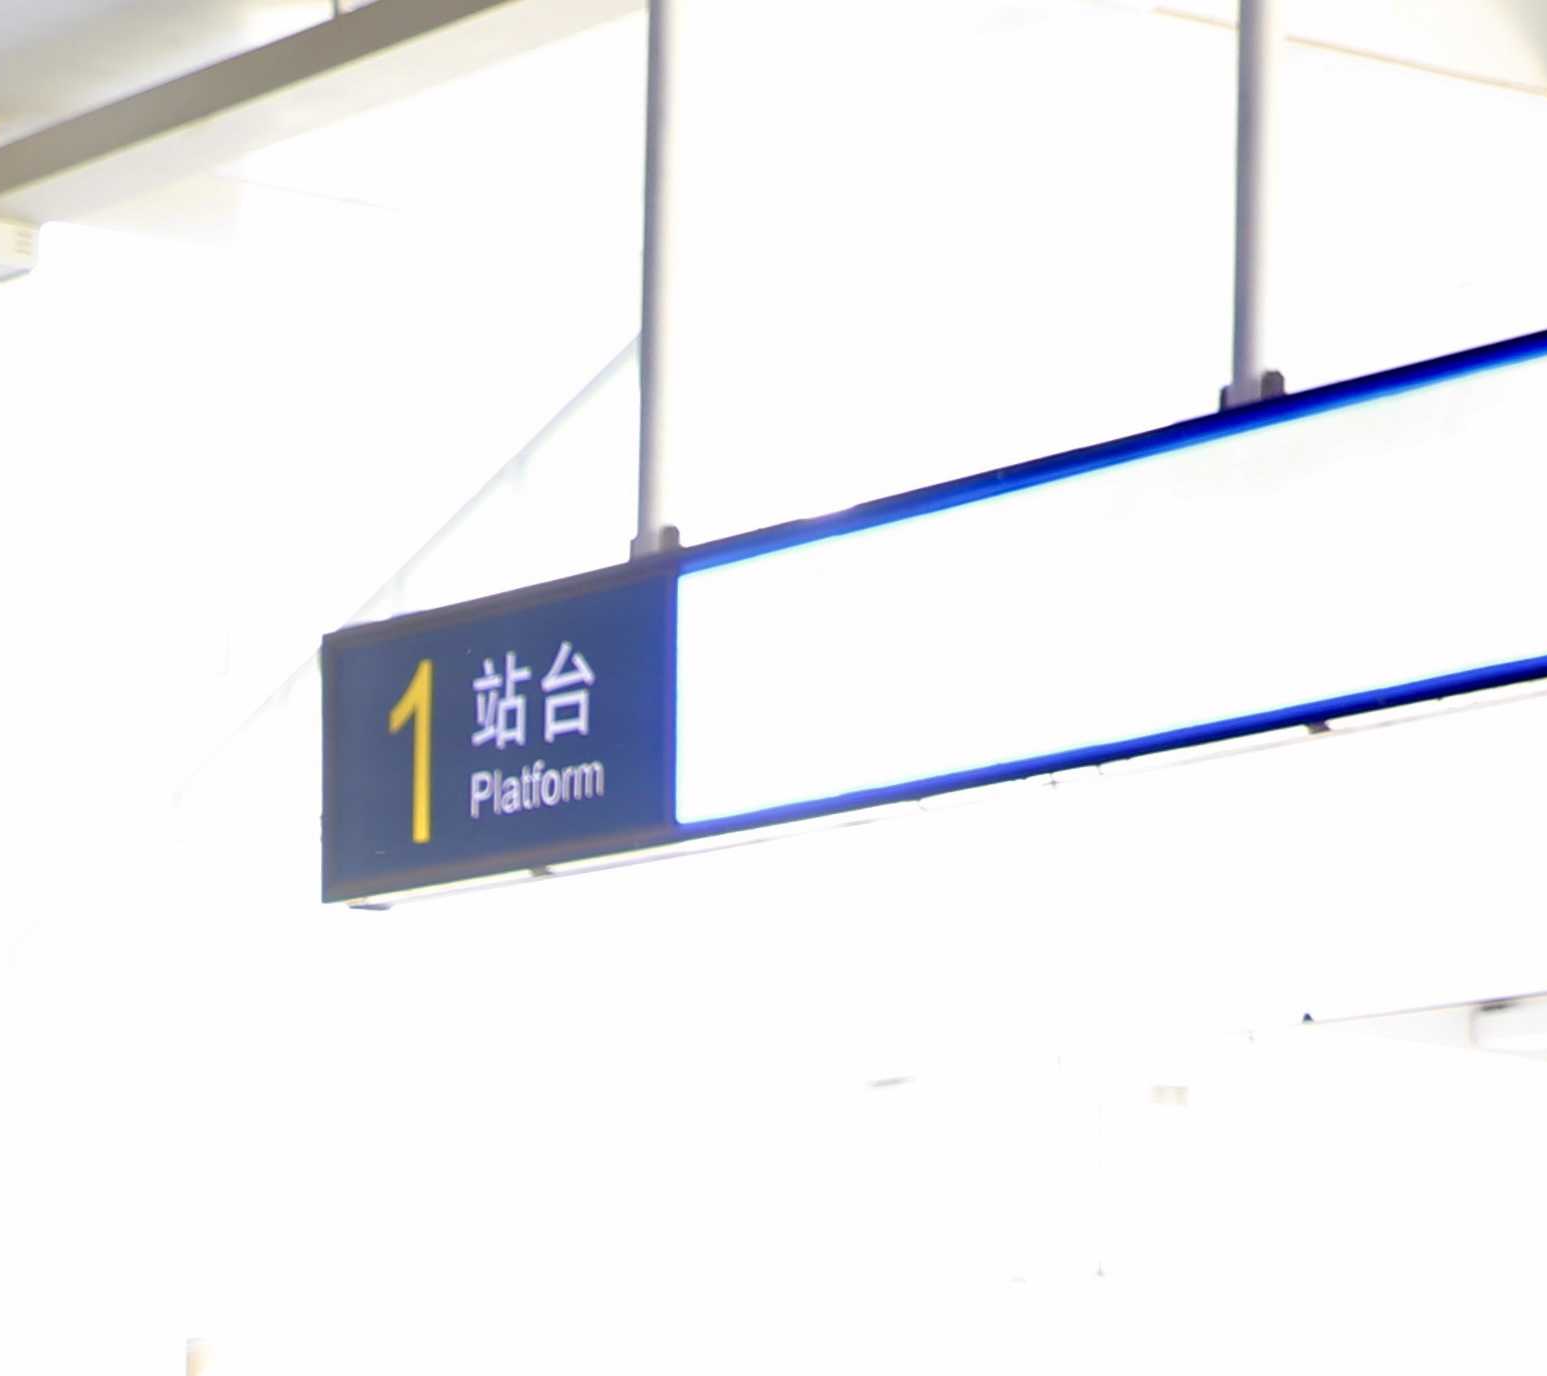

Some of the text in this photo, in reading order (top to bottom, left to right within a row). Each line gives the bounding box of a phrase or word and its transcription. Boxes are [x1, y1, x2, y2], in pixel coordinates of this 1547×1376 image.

[388, 641, 596, 844] 1 站台
[470, 760, 605, 818] Platform
